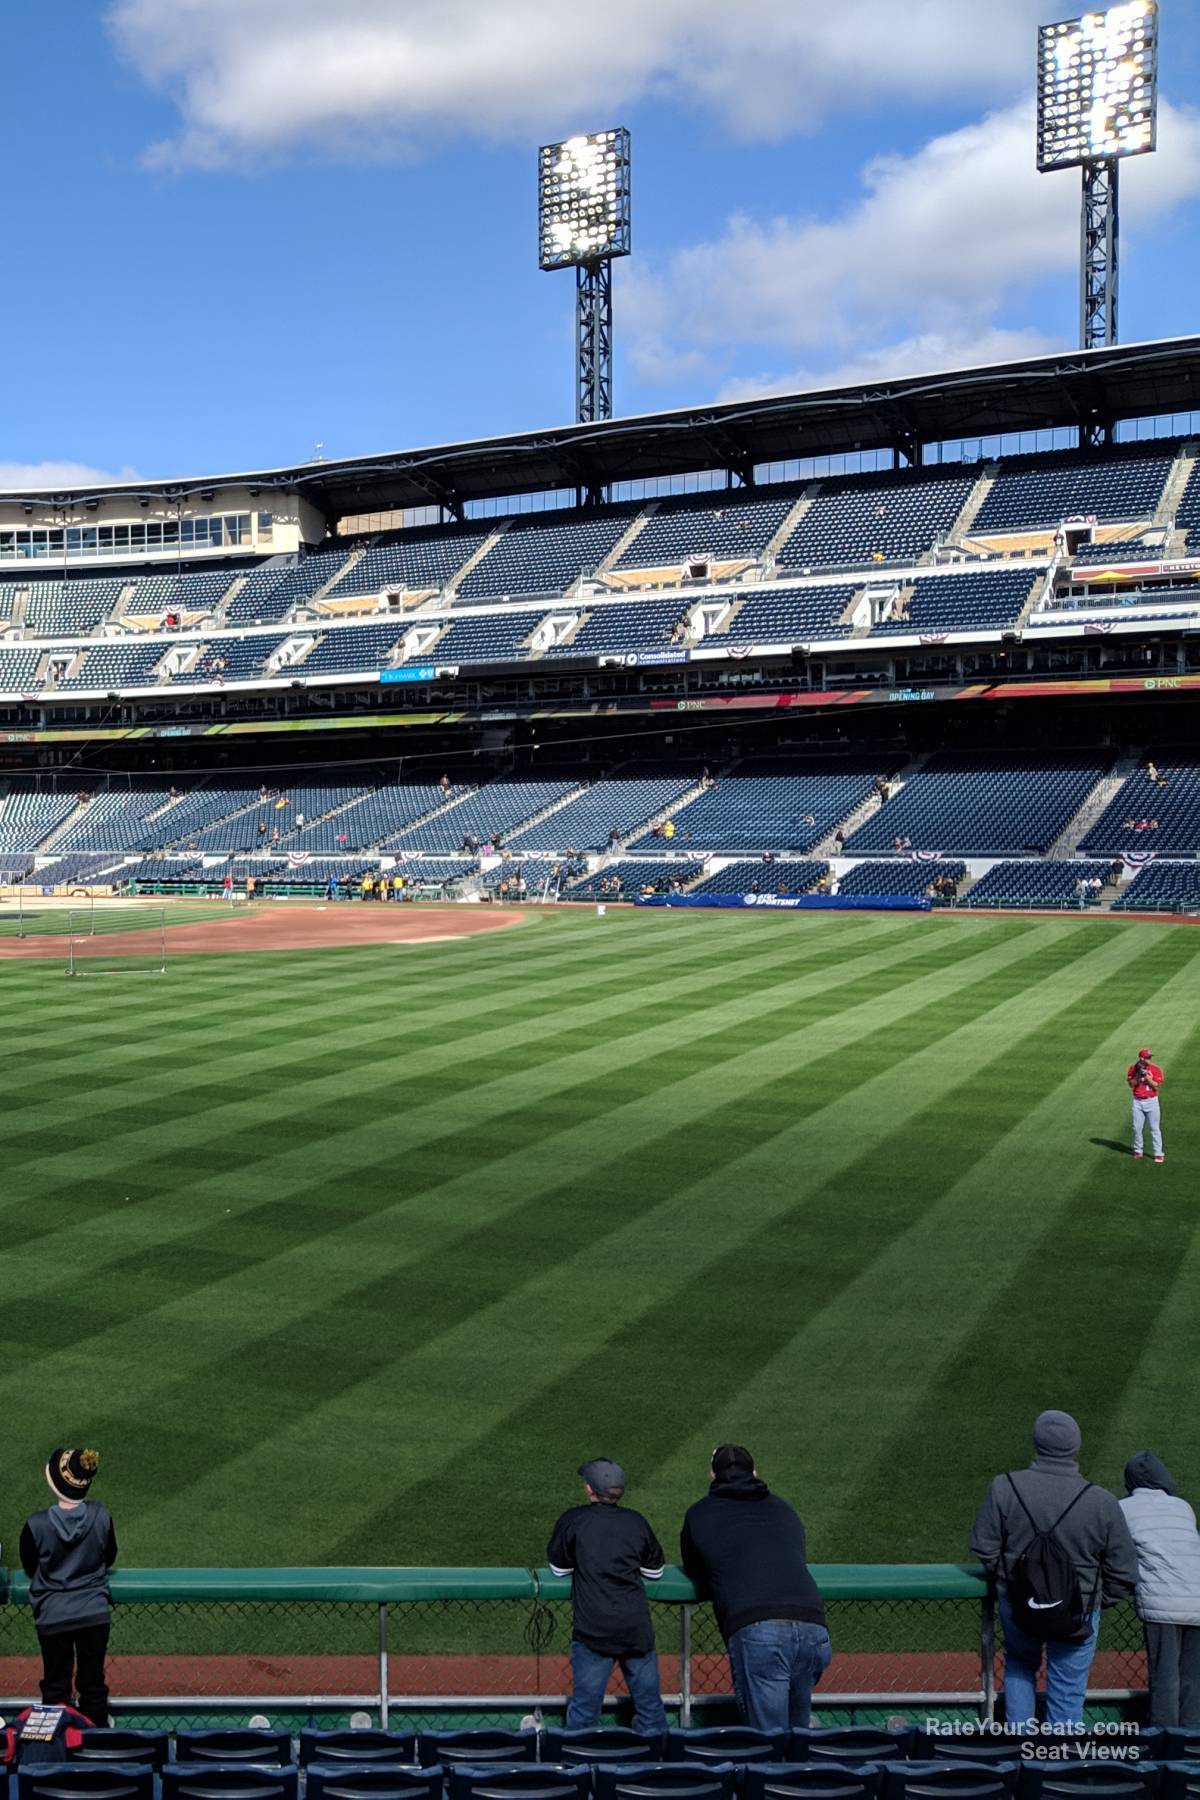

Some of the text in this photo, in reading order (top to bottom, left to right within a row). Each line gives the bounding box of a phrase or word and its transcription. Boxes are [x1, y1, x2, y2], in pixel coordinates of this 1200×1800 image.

[640, 650, 686, 660] Consolidated
[1158, 680, 1181, 688] PNC
[889, 691, 934, 701] OPENING DAY
